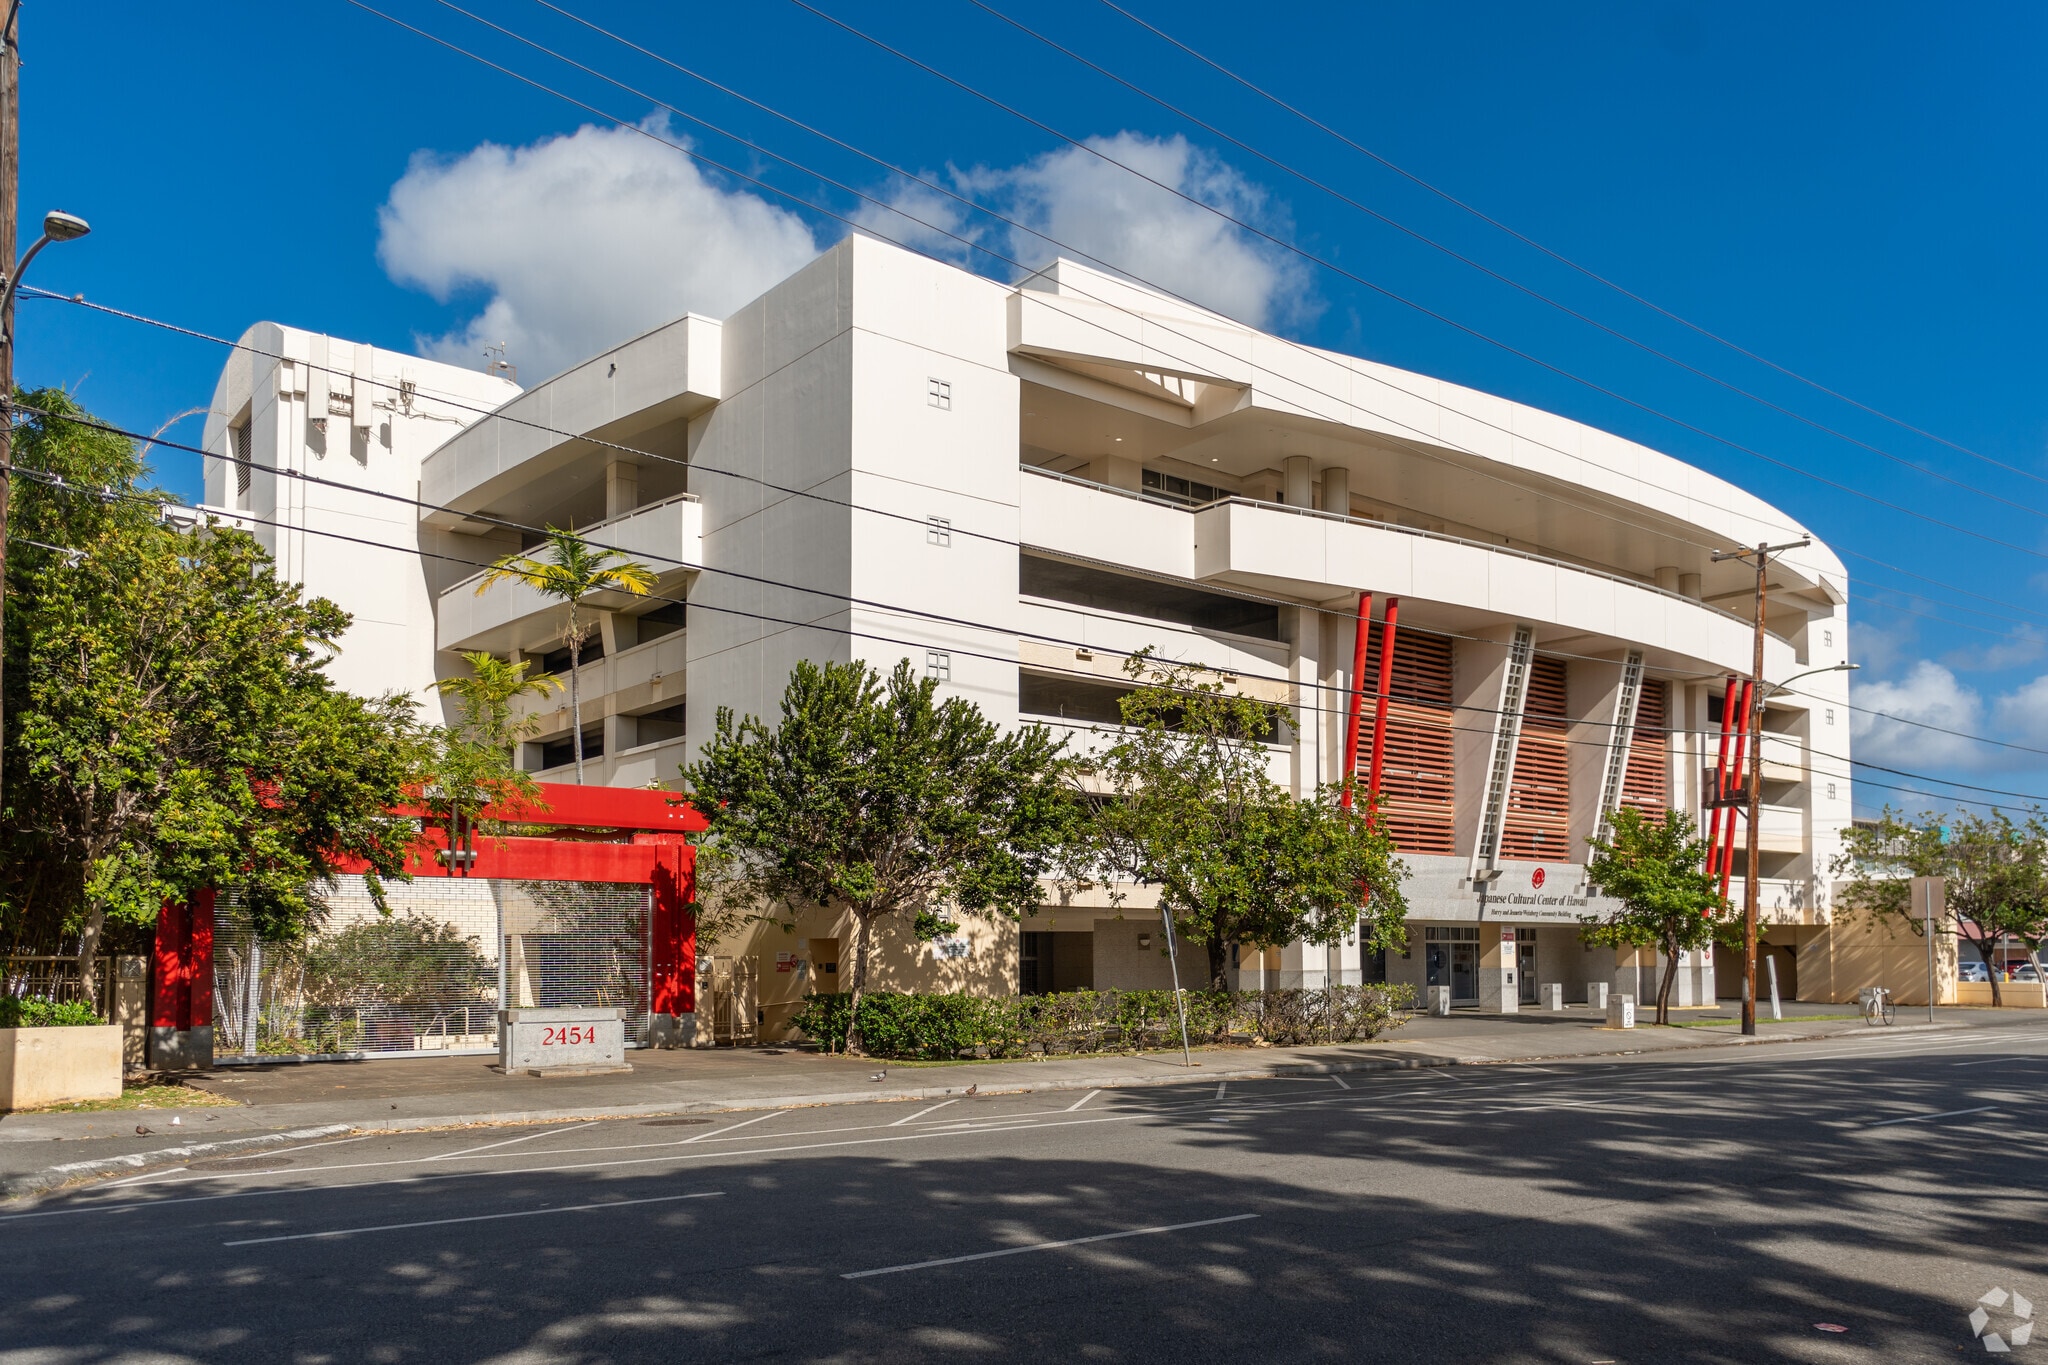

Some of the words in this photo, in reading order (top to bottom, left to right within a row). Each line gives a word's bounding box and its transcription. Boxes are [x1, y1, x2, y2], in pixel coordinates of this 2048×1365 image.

[1476, 892, 1507, 906] Japanese
[1508, 893, 1537, 905] Cultural
[1537, 894, 1558, 906] Center
[1558, 895, 1567, 906] of
[1491, 909, 1502, 917] Harry
[1557, 910, 1571, 918] Building
[542, 1026, 595, 1046] 2454
